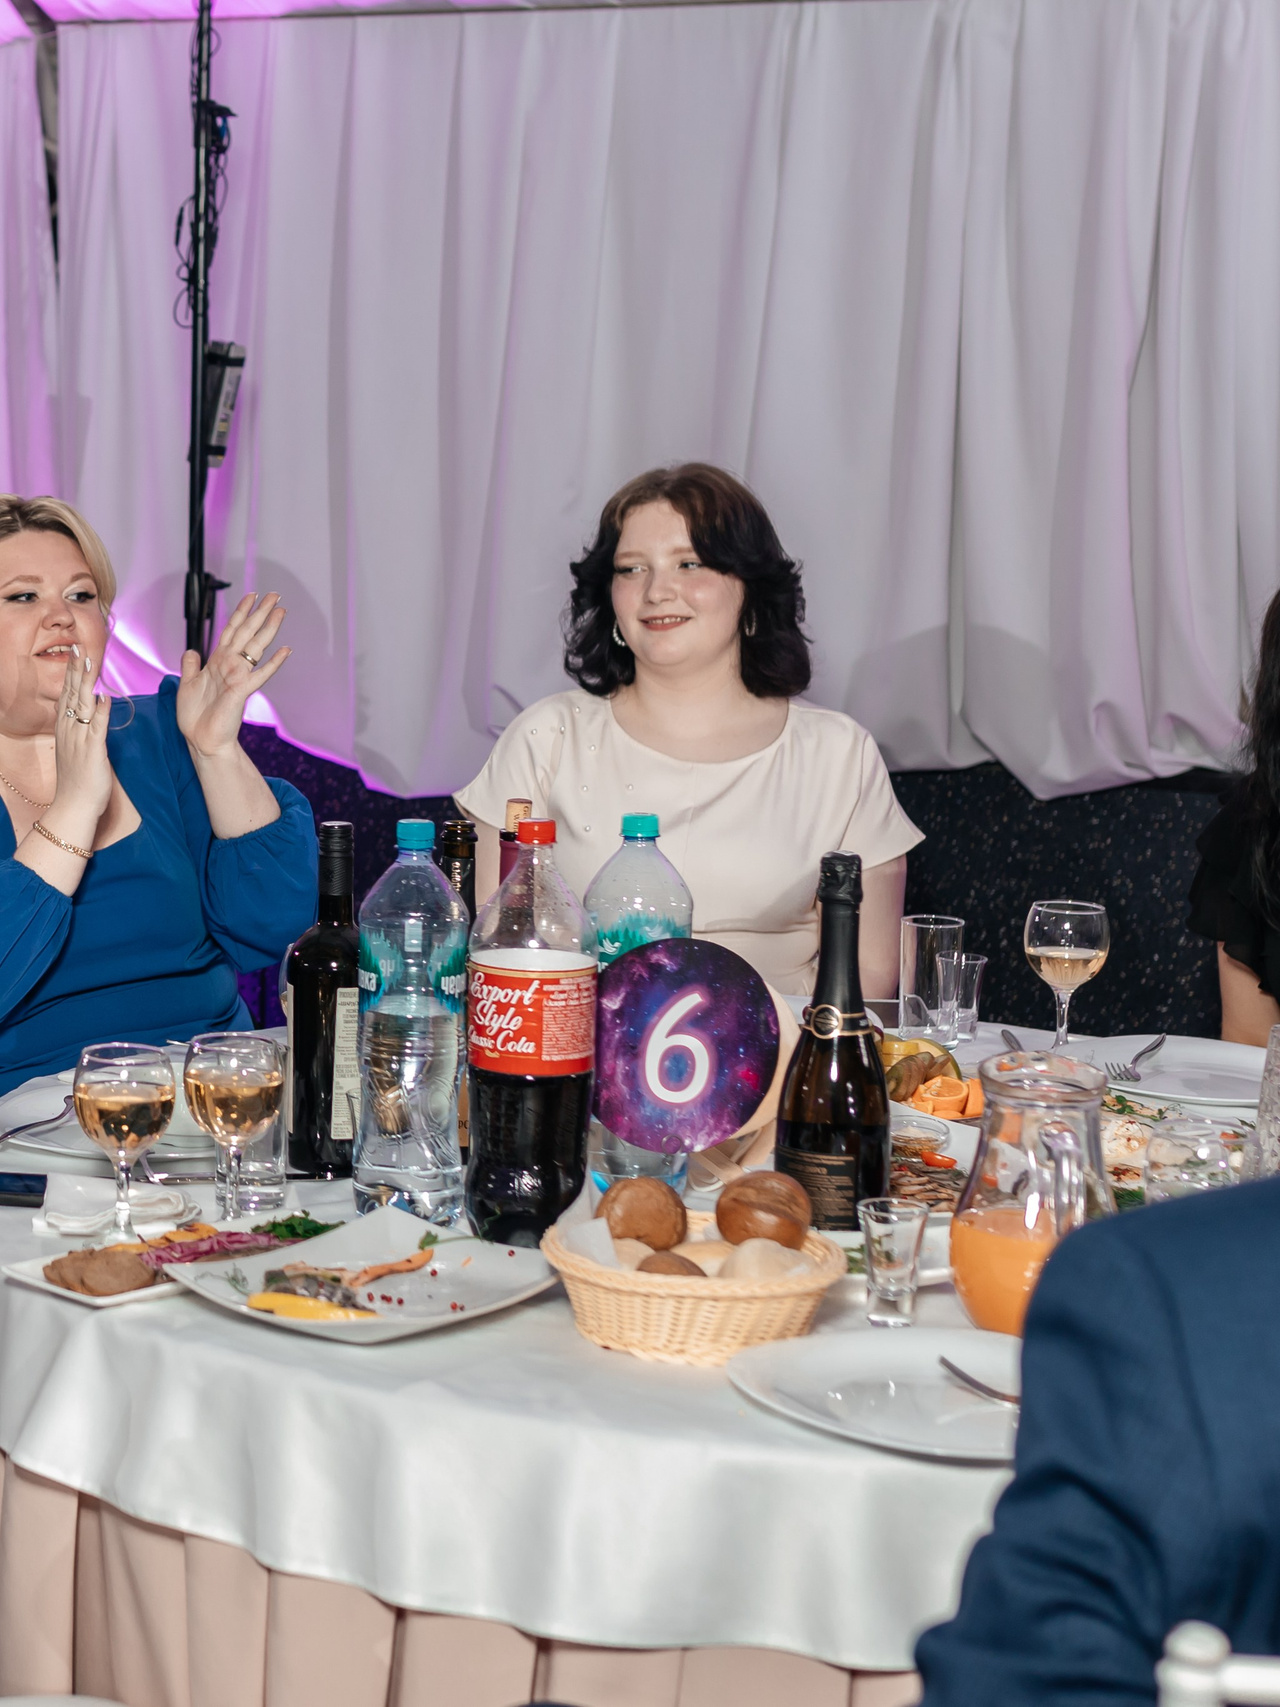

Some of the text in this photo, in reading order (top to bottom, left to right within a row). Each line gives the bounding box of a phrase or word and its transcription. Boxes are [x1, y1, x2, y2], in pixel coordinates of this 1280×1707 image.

[471, 972, 540, 1013] Export
[474, 1000, 523, 1036] Style
[496, 1030, 536, 1054] Cola
[645, 993, 709, 1103] 6
